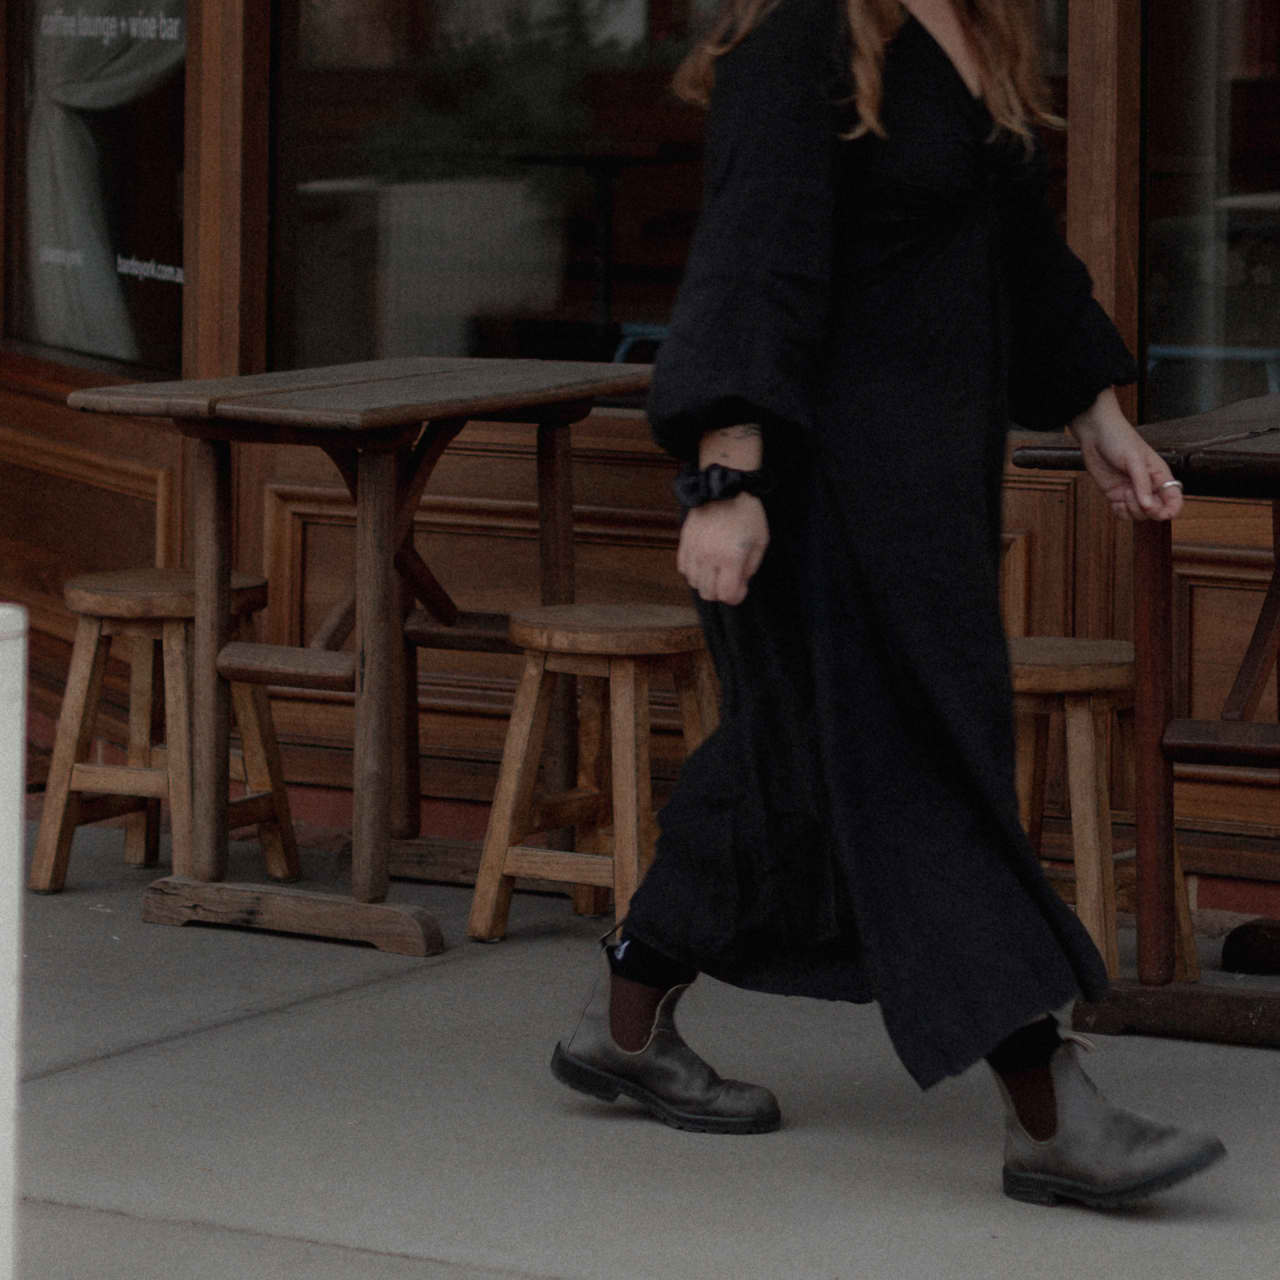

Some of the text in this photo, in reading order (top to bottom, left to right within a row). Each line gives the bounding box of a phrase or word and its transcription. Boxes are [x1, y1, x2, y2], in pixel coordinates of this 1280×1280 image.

[78, 8, 117, 46] lounge
[128, 9, 156, 40] wine
[159, 9, 181, 40] bar
